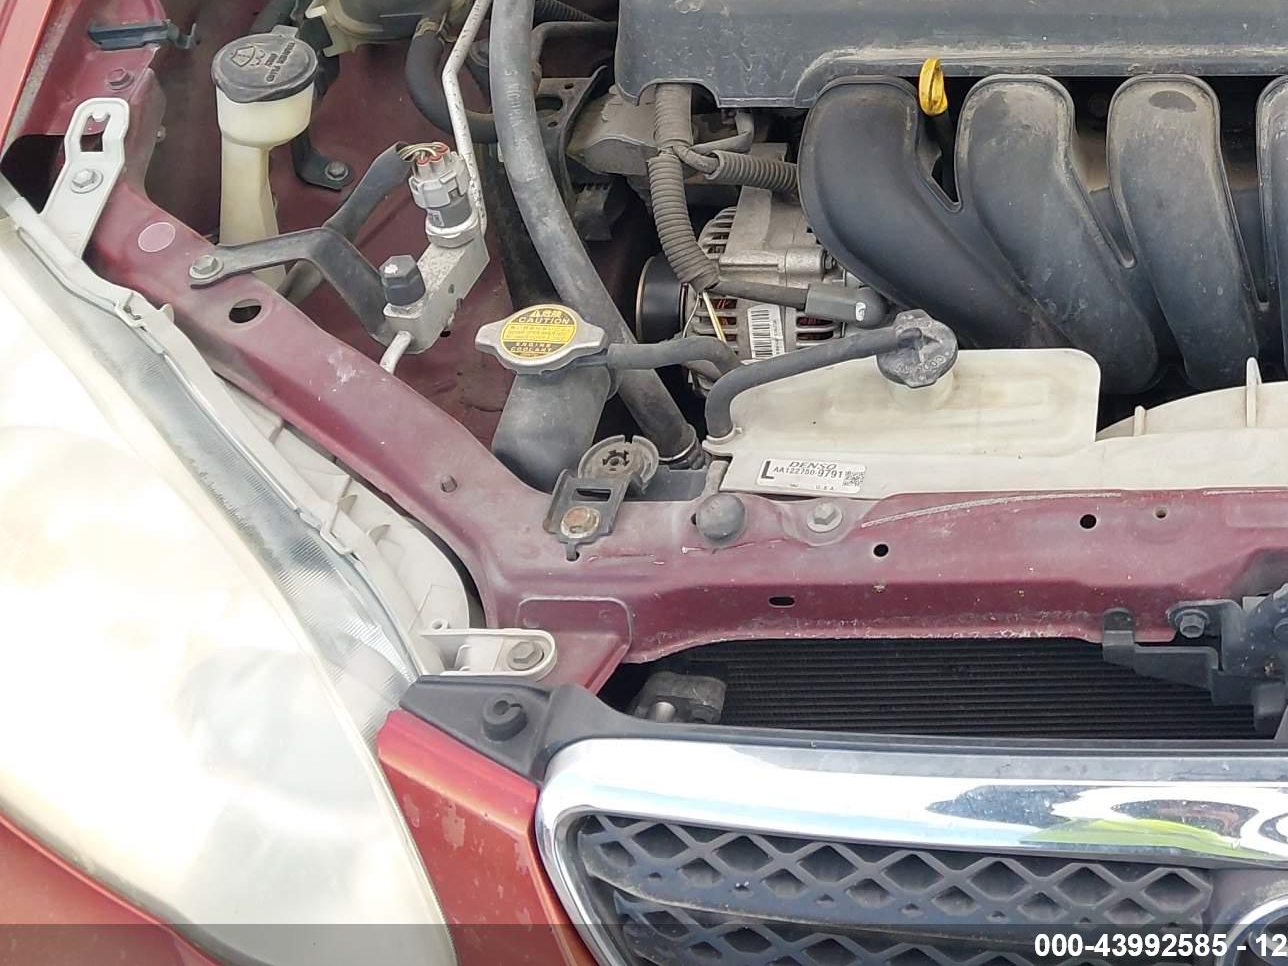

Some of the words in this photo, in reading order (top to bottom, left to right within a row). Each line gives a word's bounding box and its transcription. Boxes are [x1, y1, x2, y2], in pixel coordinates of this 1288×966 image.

[518, 316, 571, 325] CAUTION
[760, 460, 775, 480] L
[788, 461, 838, 470] DENSO
